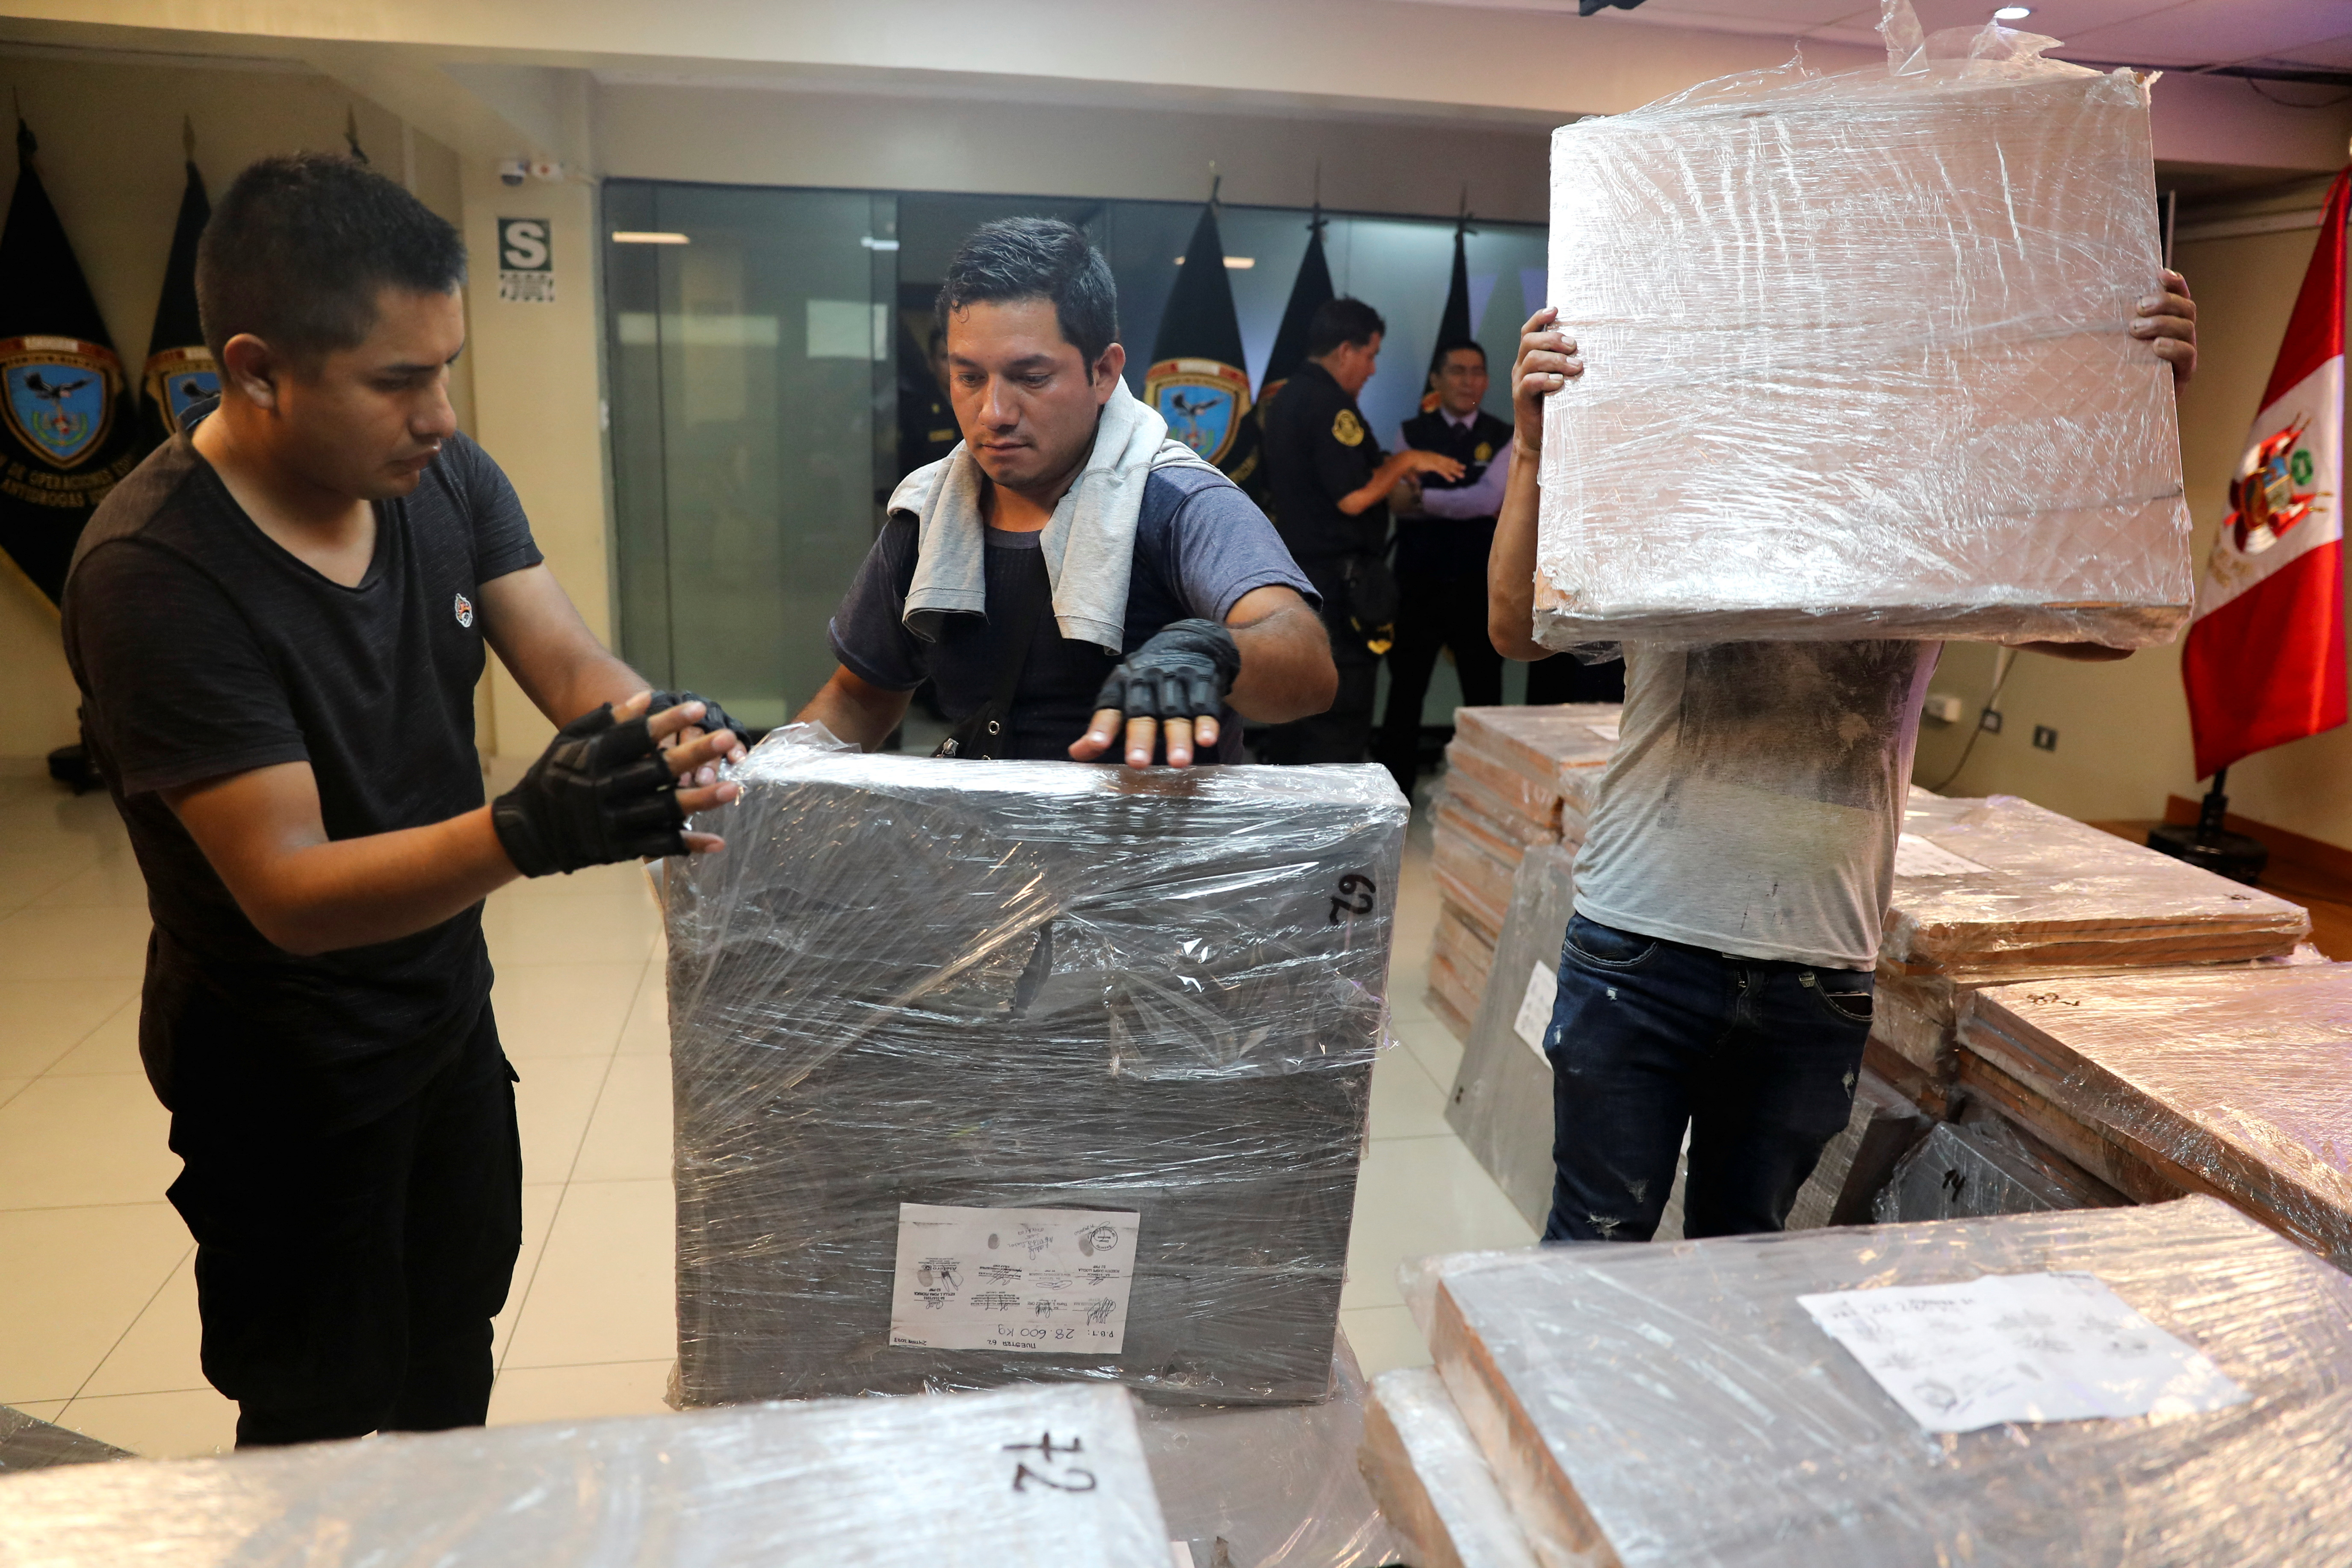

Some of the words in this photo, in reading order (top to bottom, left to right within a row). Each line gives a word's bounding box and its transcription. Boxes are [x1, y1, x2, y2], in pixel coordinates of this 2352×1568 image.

[505, 222, 547, 268] S
[1329, 874, 1376, 926] 62
[1003, 1430, 1097, 1493] 72
